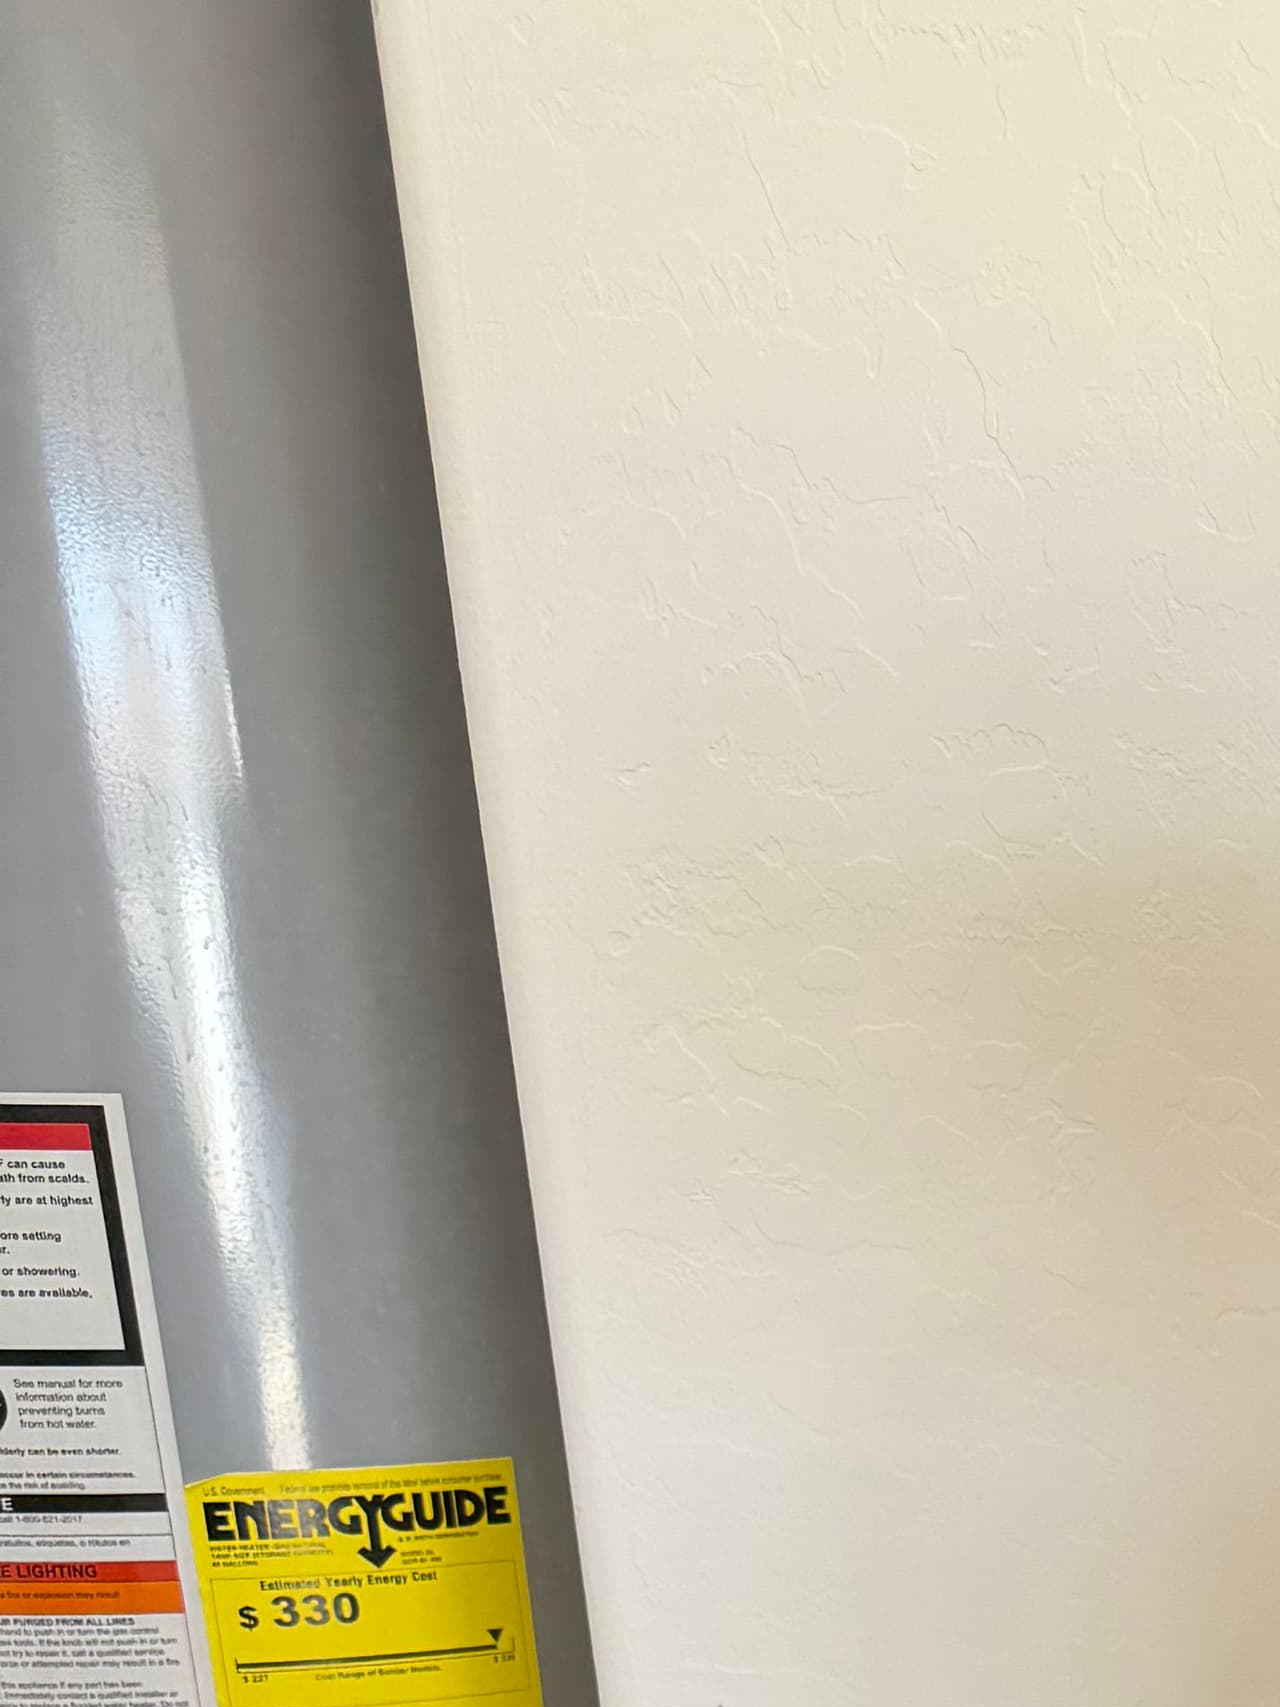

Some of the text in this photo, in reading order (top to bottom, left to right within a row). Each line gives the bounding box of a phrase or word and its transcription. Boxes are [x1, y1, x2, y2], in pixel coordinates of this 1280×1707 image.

[7, 1160, 65, 1169] can cause
[18, 1173, 45, 1183] from
[48, 1173, 90, 1184] scalds.
[15, 1195, 94, 1207] are at highest
[22, 1231, 62, 1243] setting
[17, 1267, 80, 1279] showering.
[18, 1289, 36, 1298] are
[13, 1378, 123, 1389] See manual for more
[16, 1392, 107, 1402] information about
[18, 1406, 106, 1417] preventing burns
[20, 1419, 44, 1429] from
[47, 1419, 64, 1429] hot
[28, 1448, 45, 1456] can
[47, 1447, 59, 1456] be
[203, 1486, 512, 1551] ENERGYGUIDE
[16, 1564, 98, 1579] LIGHTING
[260, 1570, 438, 1592] Estimated Yearly Energy Cost
[238, 1592, 360, 1632] $ 330
[55, 1617, 85, 1626] FROM
[86, 1617, 103, 1626] ALL
[339, 1670, 366, 1682] Range
[367, 1668, 377, 1678] of
